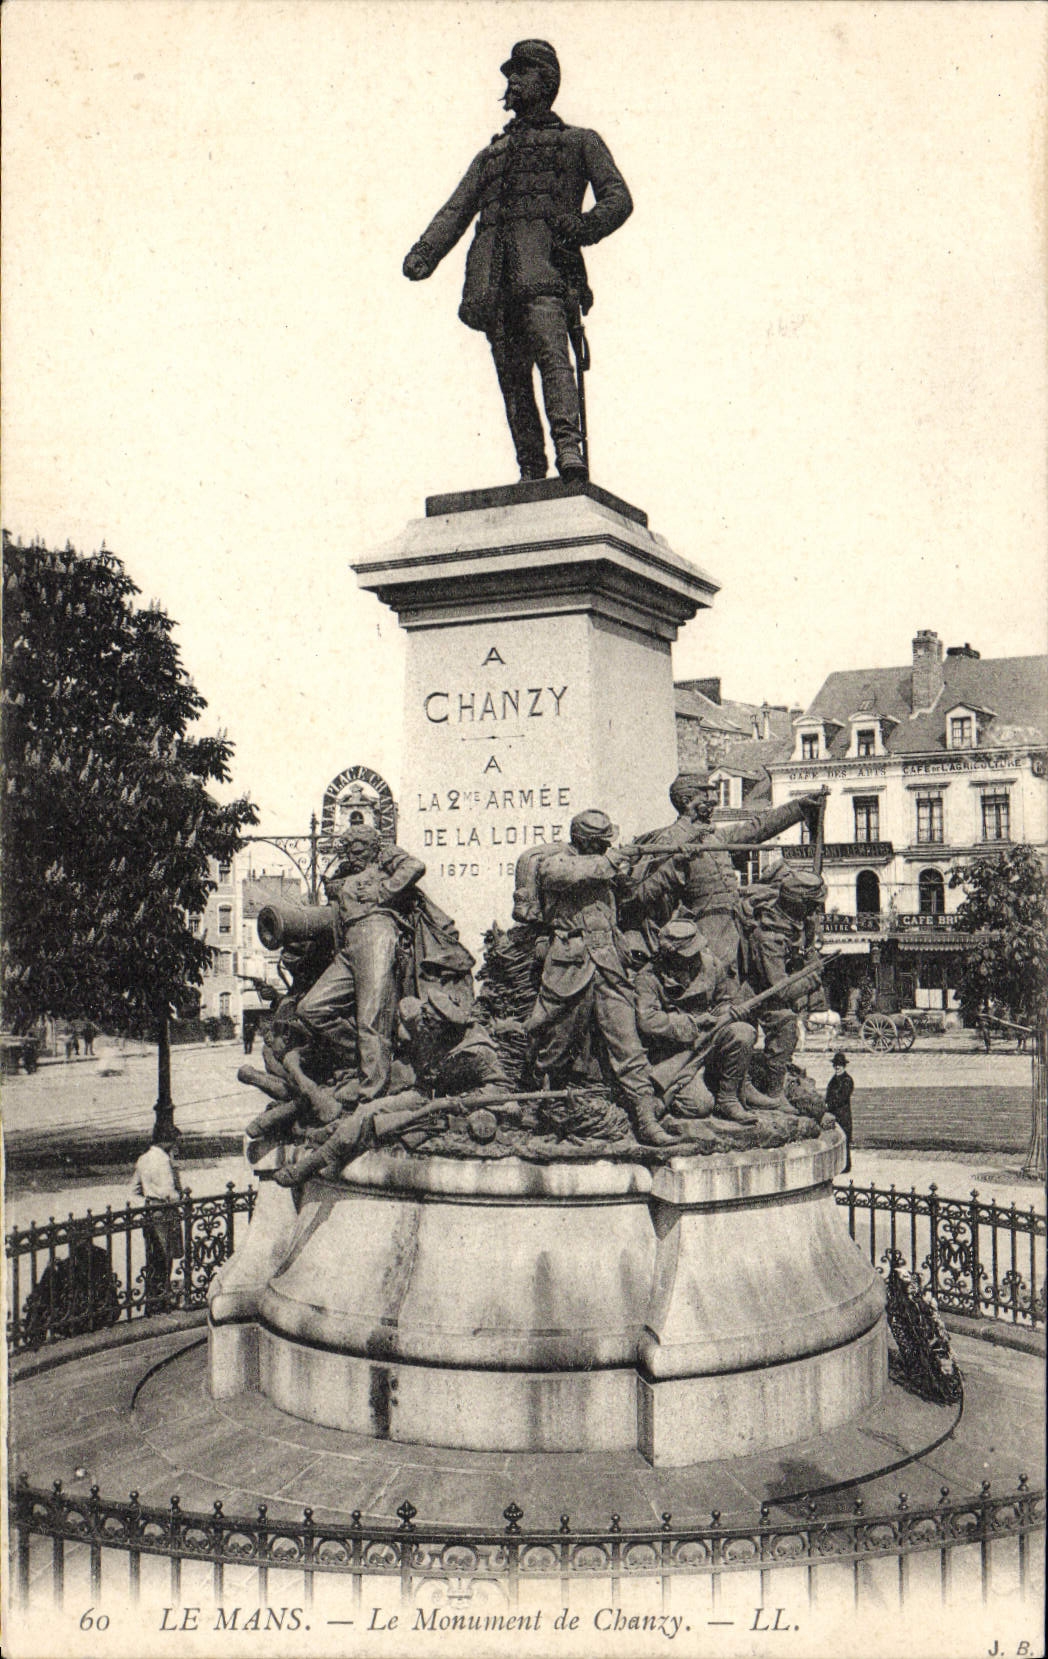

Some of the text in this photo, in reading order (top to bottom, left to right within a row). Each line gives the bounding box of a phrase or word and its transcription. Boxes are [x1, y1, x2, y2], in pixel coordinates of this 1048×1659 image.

[481, 646, 506, 666] A
[423, 685, 568, 724] CHANZY
[483, 755, 502, 774] A
[418, 793, 441, 812] LA
[486, 784, 571, 809] ARMÉE
[424, 825, 564, 847] DE LA LOIRE
[439, 863, 480, 877] 1870
[903, 915, 934, 925] CAFE
